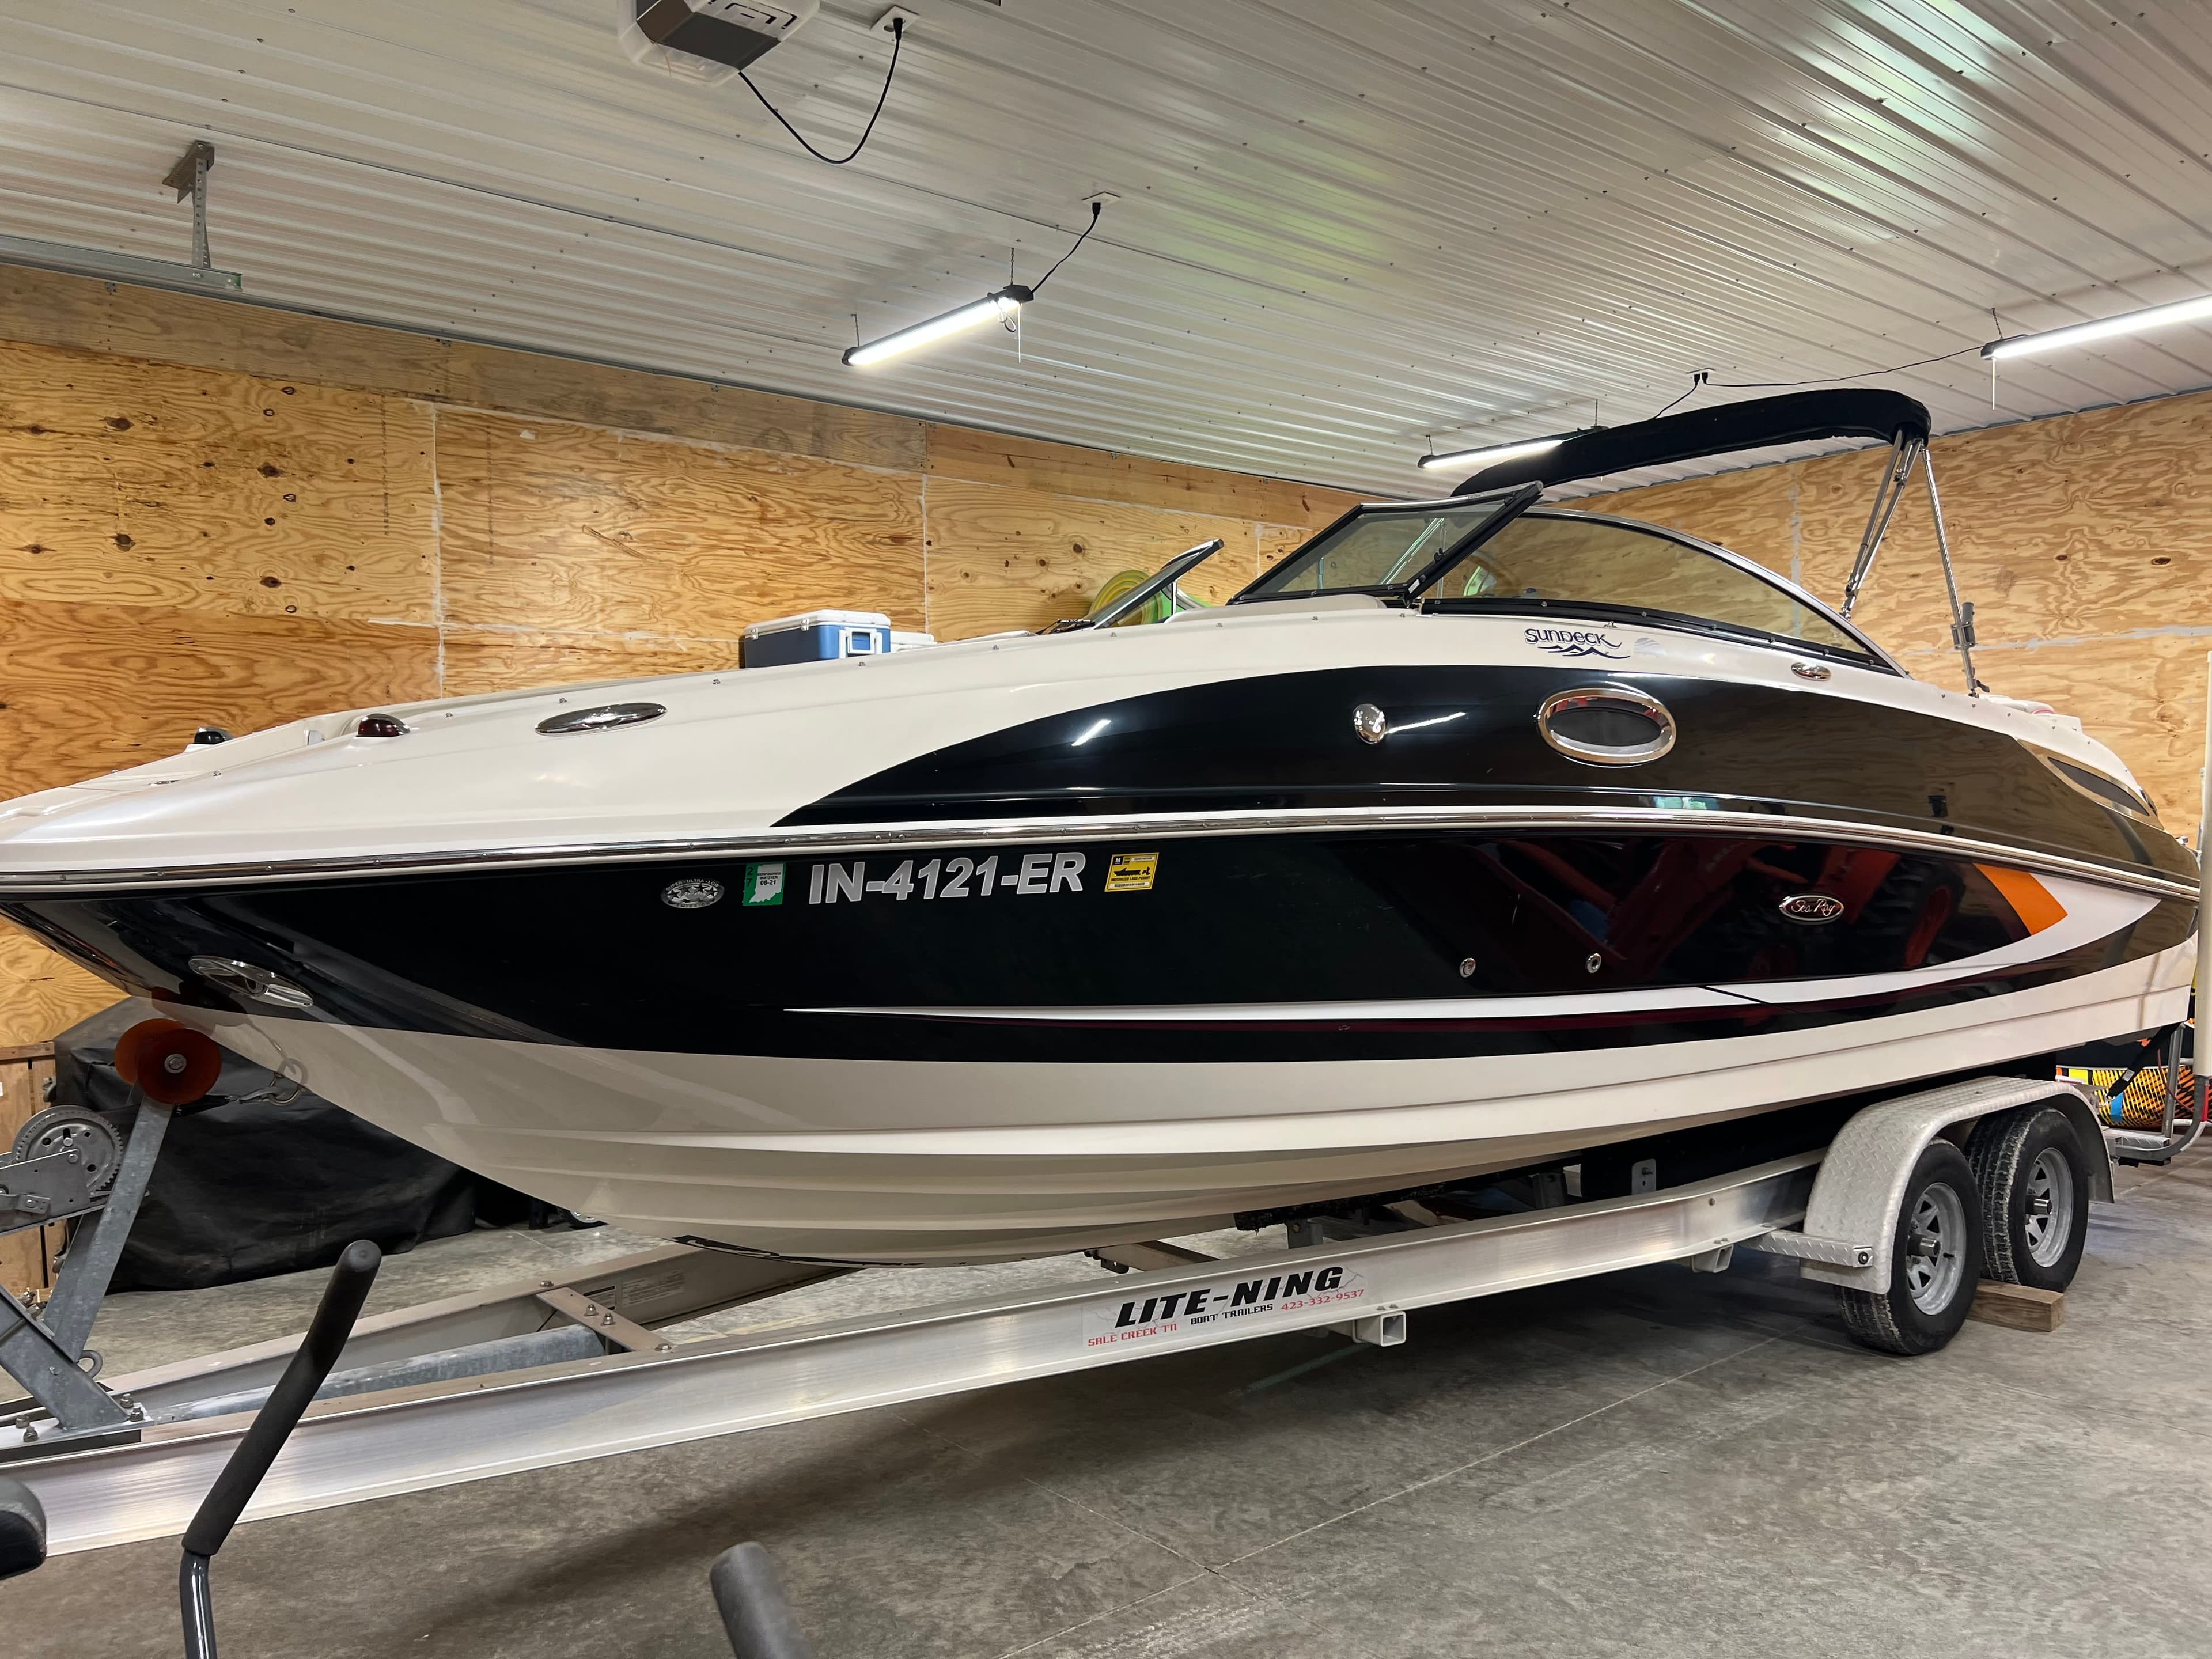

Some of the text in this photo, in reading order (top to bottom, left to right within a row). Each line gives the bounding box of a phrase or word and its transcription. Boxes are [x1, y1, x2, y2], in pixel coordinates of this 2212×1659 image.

[809, 851, 1086, 904] IN-4121-ER
[1791, 898, 1836, 916] Sea Ray
[1115, 1266, 1343, 1328] LITE-NING
[1190, 1289, 1365, 1325] BOAT TRAILERS 423-332-9537
[1088, 1333, 1118, 1347] SALE
[1121, 1327, 1157, 1340] CREEK
